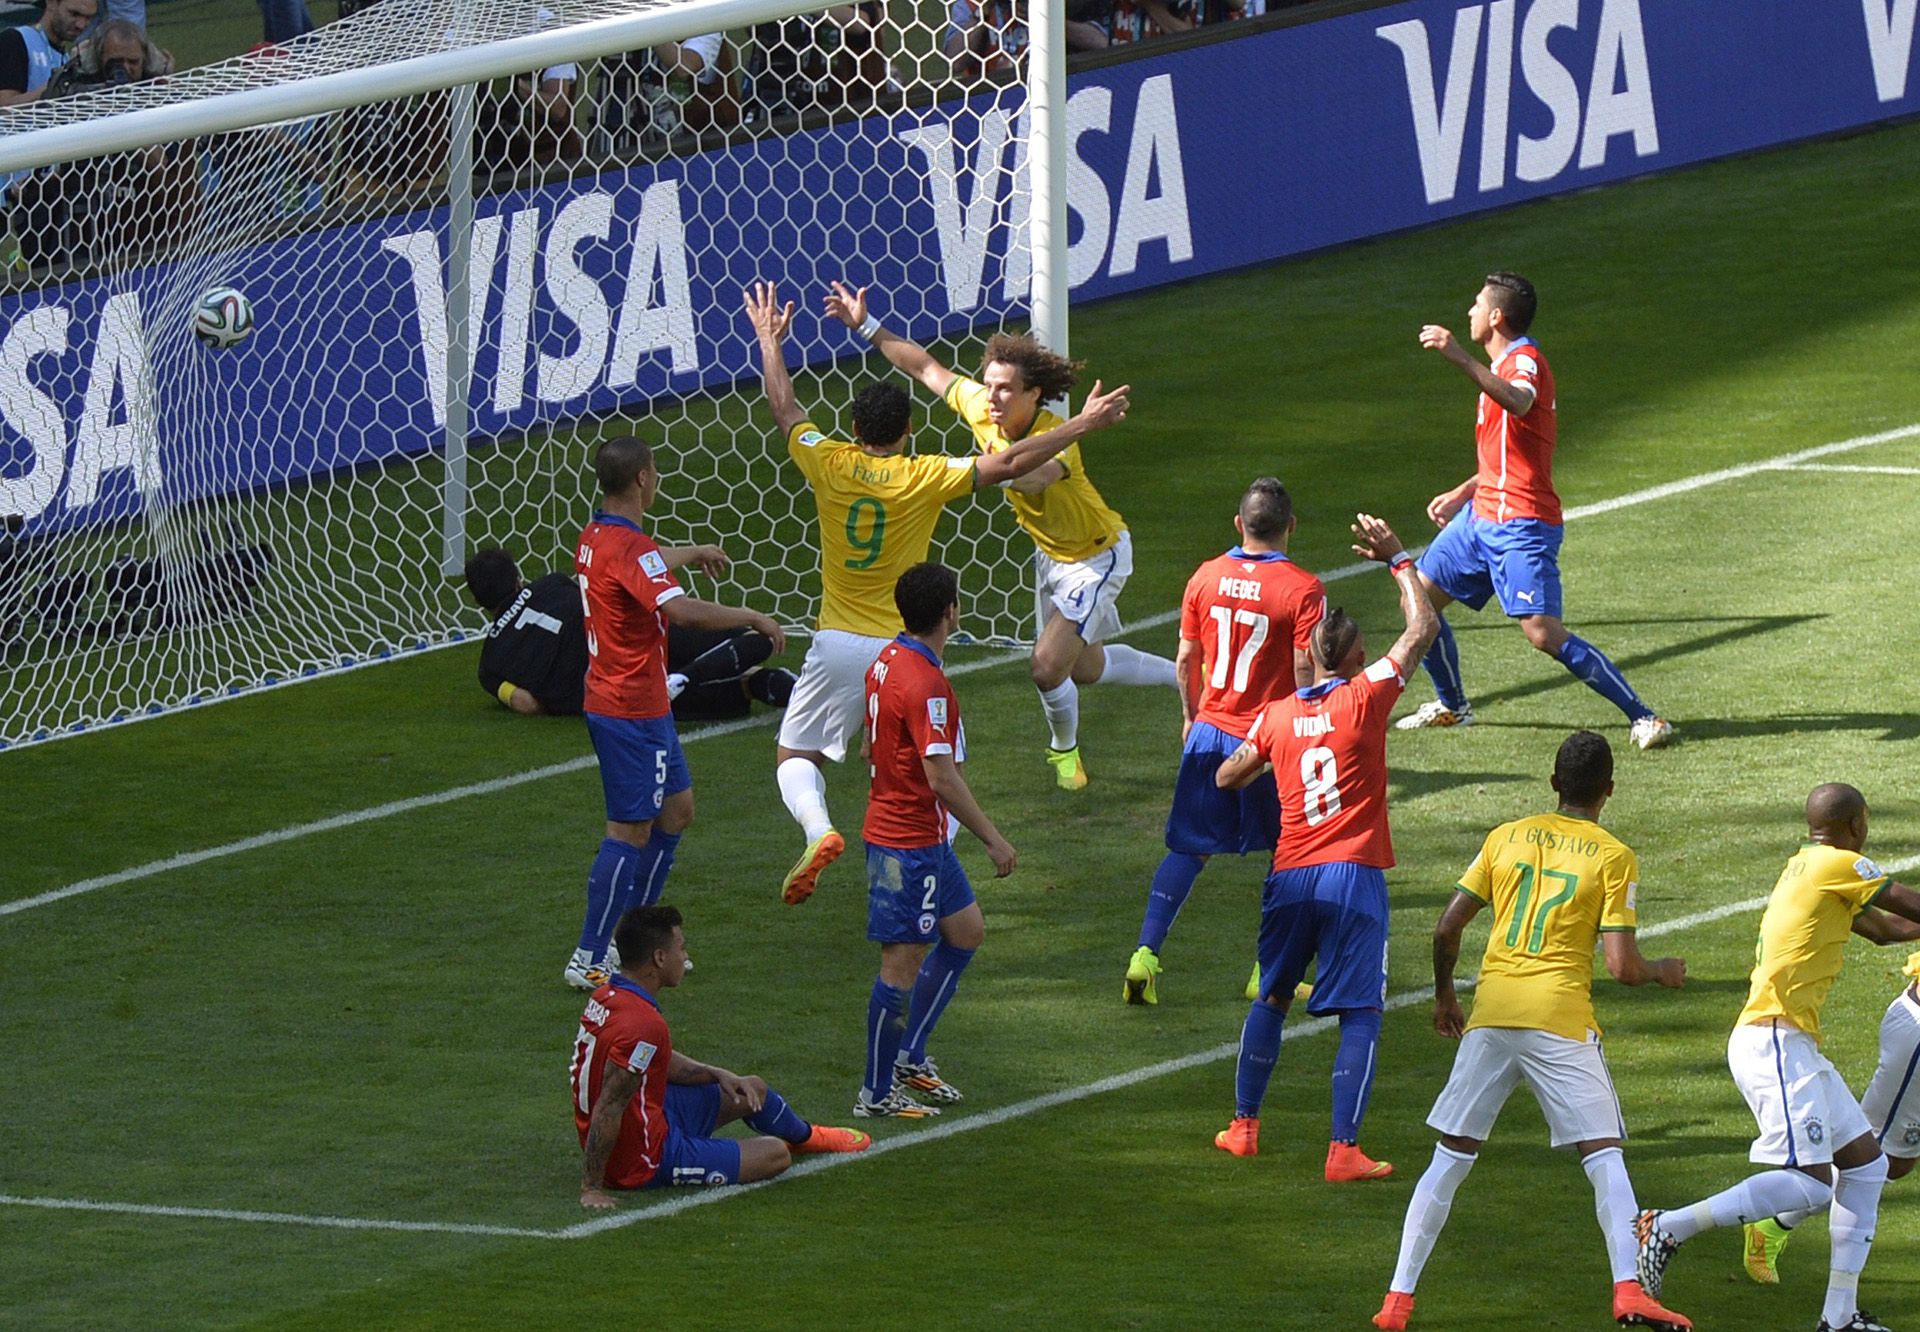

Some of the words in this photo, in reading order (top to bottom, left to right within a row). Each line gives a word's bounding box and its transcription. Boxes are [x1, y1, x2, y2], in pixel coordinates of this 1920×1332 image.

[1376, 0, 1660, 205] VISA
[380, 179, 700, 428] VISA
[852, 464, 889, 485] FRED
[845, 496, 886, 569] 9
[1067, 580, 1087, 609] 4
[1218, 576, 1262, 602] MEDEL
[1209, 605, 1270, 693] 17
[1293, 712, 1336, 738] VIDAL
[655, 750, 668, 785] 5
[1300, 746, 1343, 827] 8
[1526, 826, 1600, 858] GUSTAVO
[921, 874, 937, 910] 2
[1505, 863, 1579, 955] 17
